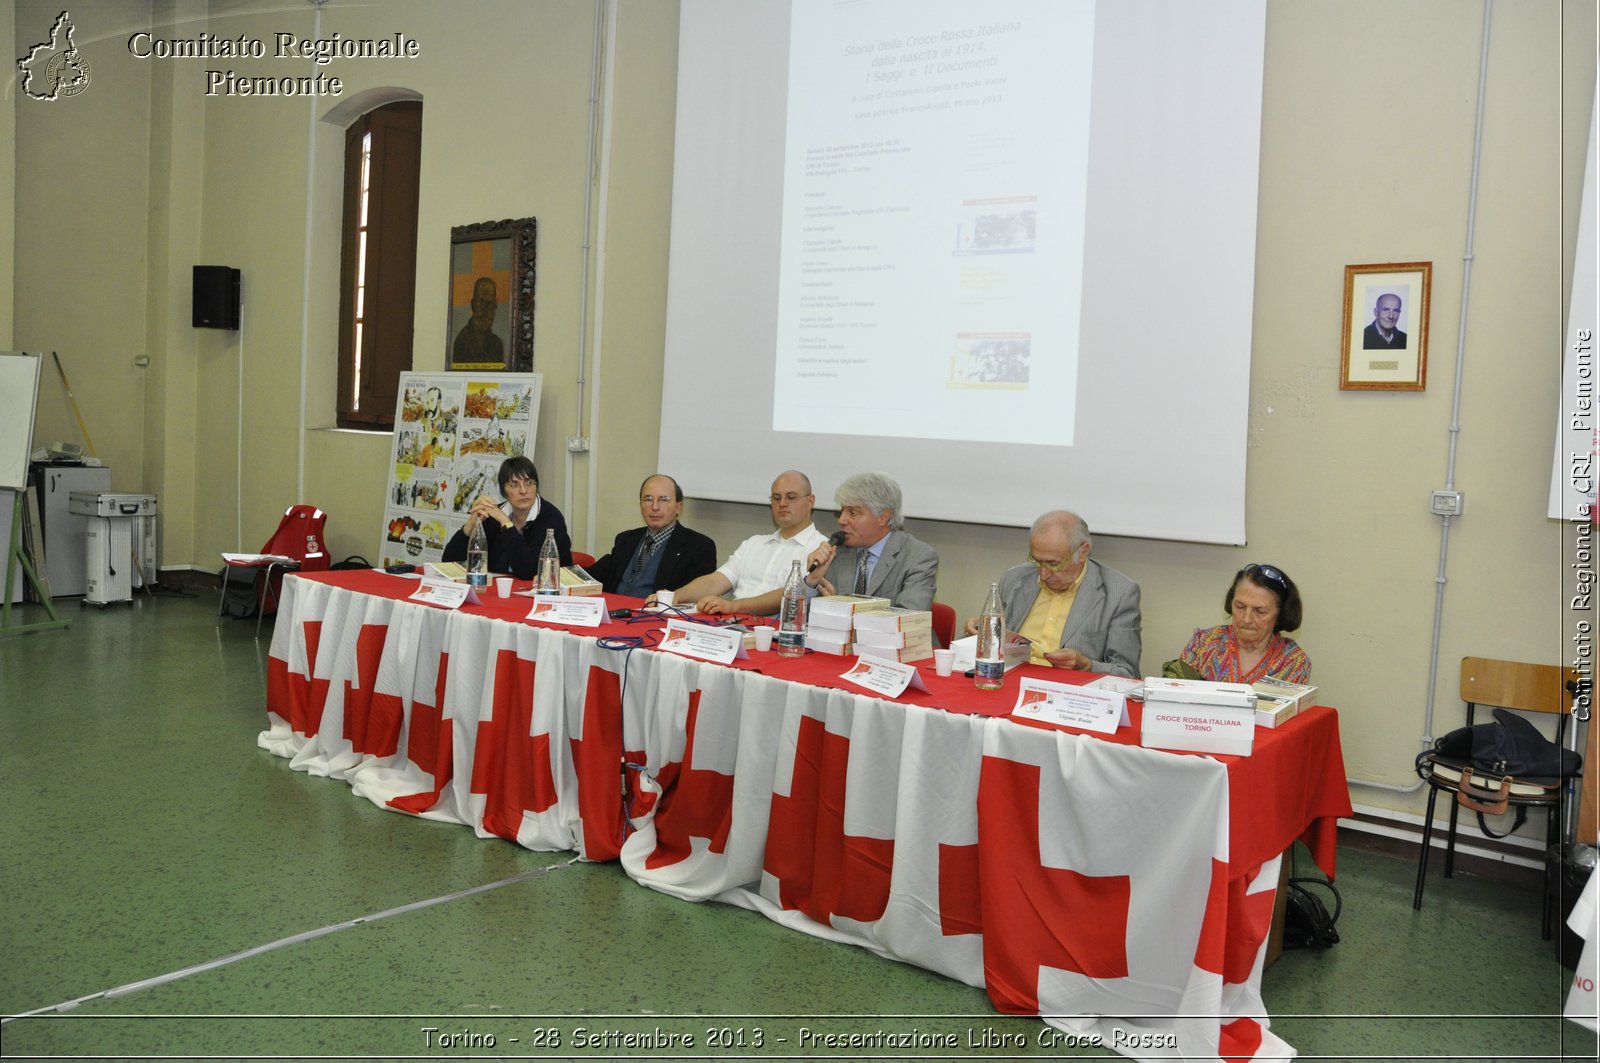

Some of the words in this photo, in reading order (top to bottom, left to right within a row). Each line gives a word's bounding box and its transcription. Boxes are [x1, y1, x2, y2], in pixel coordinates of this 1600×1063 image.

[877, 38, 903, 52] della
[906, 33, 937, 48] Croce
[940, 28, 974, 42] Rossa
[976, 20, 1022, 37] Italiana
[899, 48, 938, 64] nascita
[873, 68, 904, 84] Saggi
[909, 67, 917, 77] e
[936, 55, 999, 74] Documenti
[1156, 714, 1181, 723] CROCE
[1183, 716, 1208, 725] ROSSA
[1209, 718, 1241, 727] ITALIANA
[1185, 724, 1212, 732] TORINO
